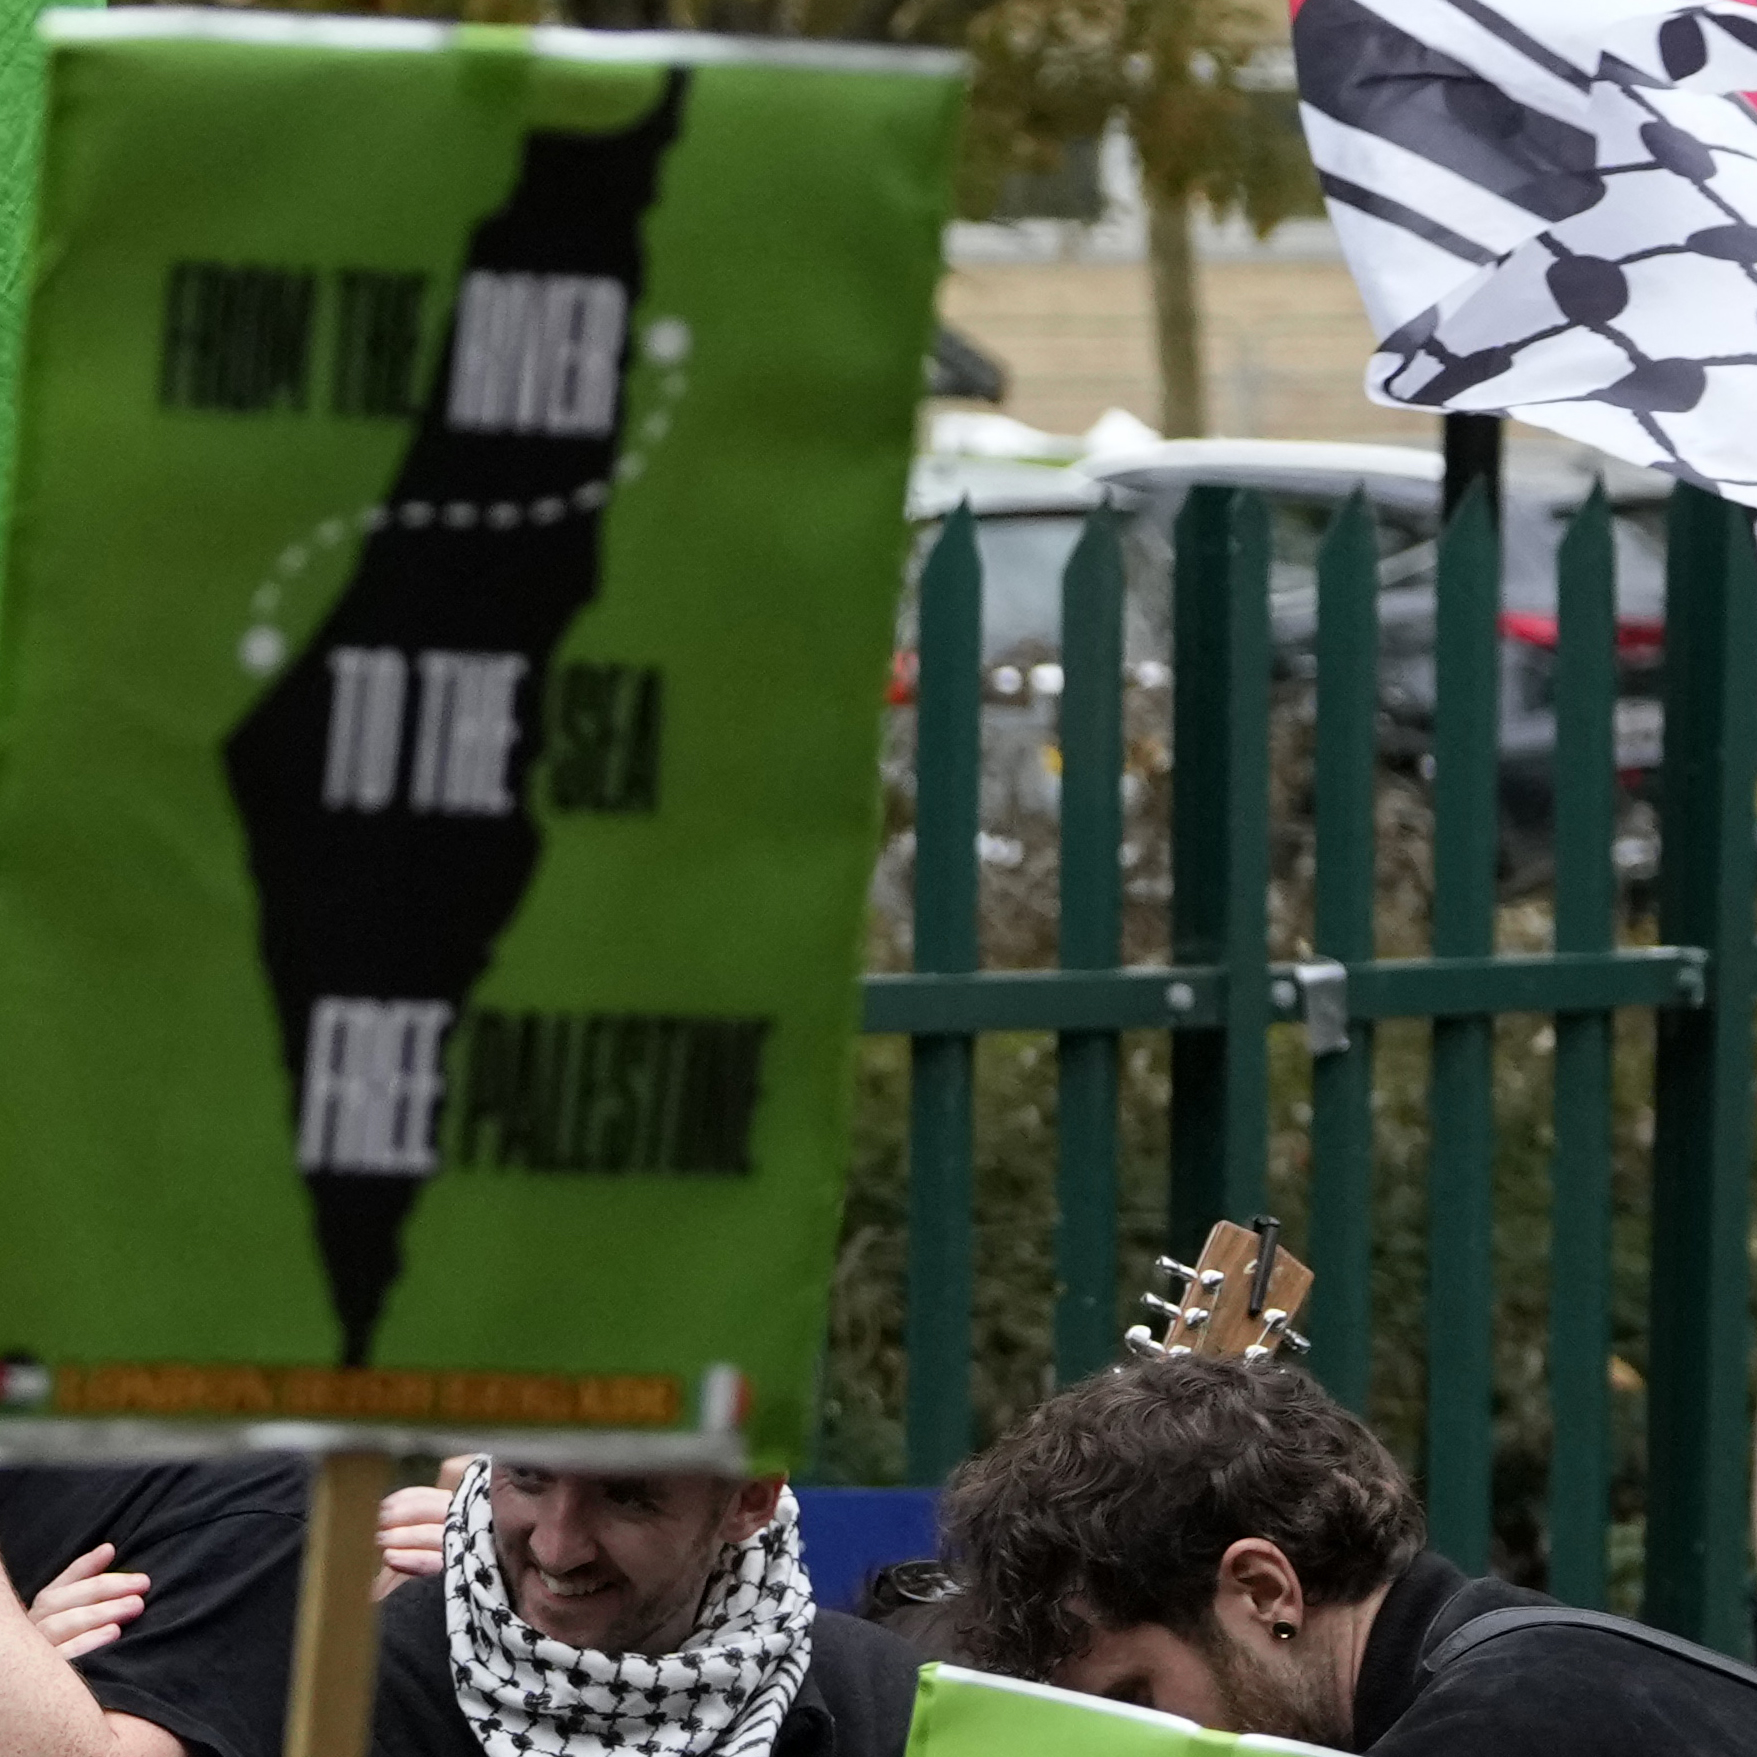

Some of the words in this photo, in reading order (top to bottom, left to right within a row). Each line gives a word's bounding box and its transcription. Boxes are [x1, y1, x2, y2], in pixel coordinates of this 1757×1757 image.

[163, 260, 317, 412] FROM
[331, 266, 430, 418] THE
[446, 269, 628, 435] RIVER
[322, 645, 410, 814] TO
[411, 649, 531, 816] THE
[553, 660, 664, 811] SEA
[297, 996, 456, 1177] FREE
[464, 1006, 772, 1172] PALESTINE
